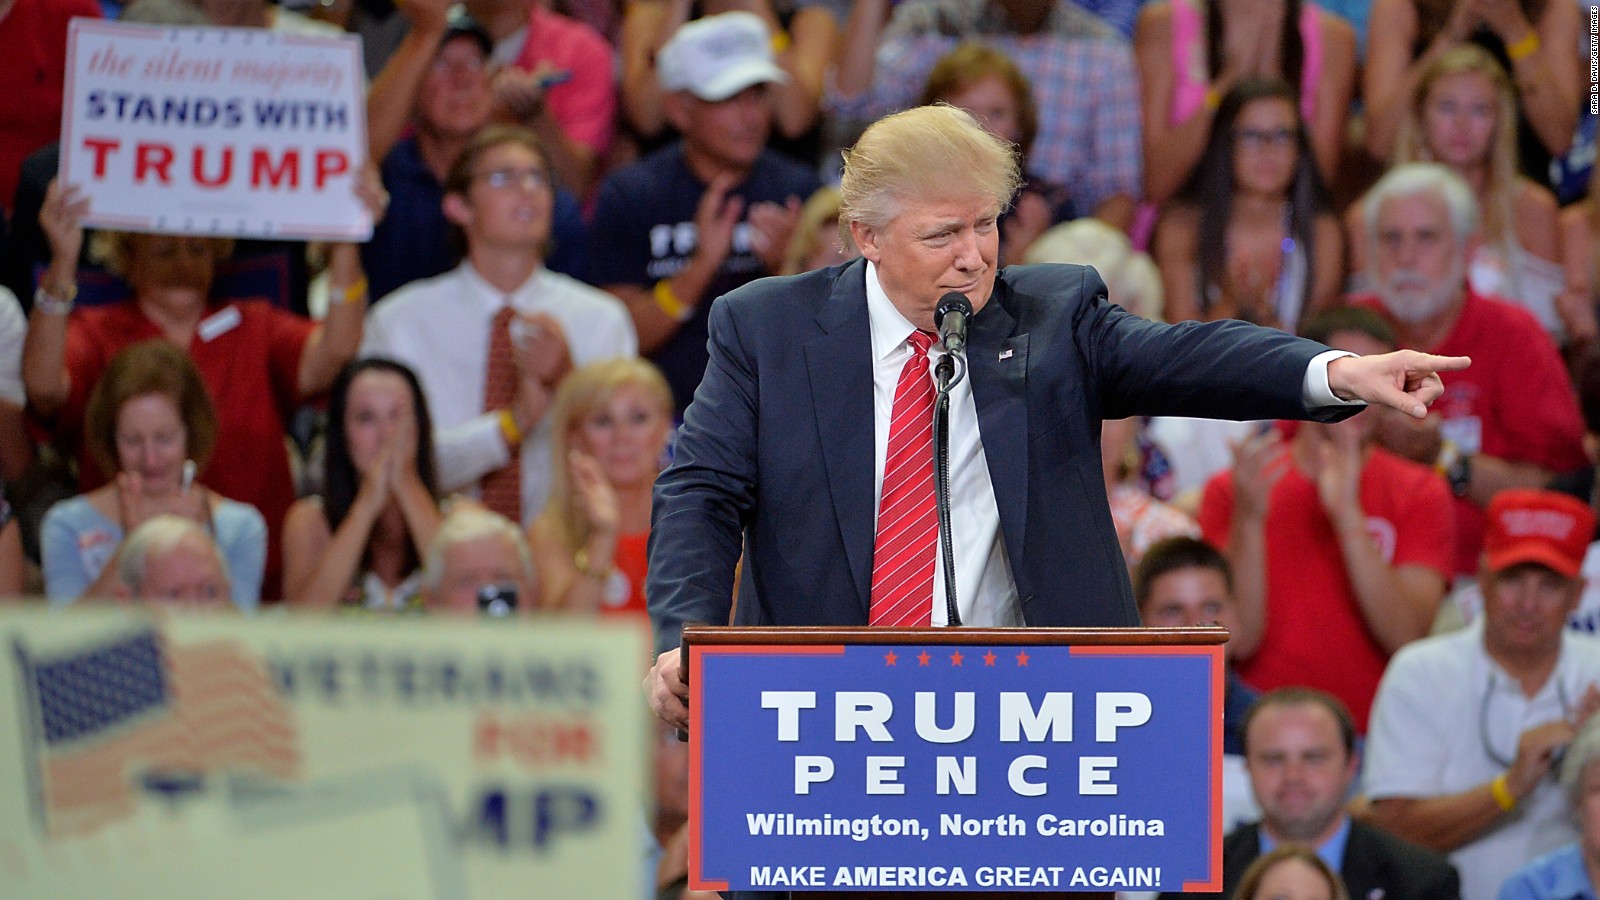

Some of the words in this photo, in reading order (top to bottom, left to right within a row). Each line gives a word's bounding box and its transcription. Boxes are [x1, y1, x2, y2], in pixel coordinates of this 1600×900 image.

[88, 43, 133, 77] the
[143, 50, 224, 82] silent
[231, 55, 345, 94] majority
[86, 90, 243, 128] STANDS
[253, 100, 347, 132] WITH
[83, 137, 349, 190] TRUMP
[761, 691, 1153, 744] TRUMP
[794, 755, 1119, 797] PENCE
[746, 813, 929, 842] Wilmington,
[940, 813, 1026, 837] North
[1036, 813, 1165, 837] Carolina
[750, 866, 826, 887] MAKE
[833, 866, 968, 887] AMERICA
[975, 866, 1065, 887] GREAT
[1069, 866, 1161, 887] AGAIN!
